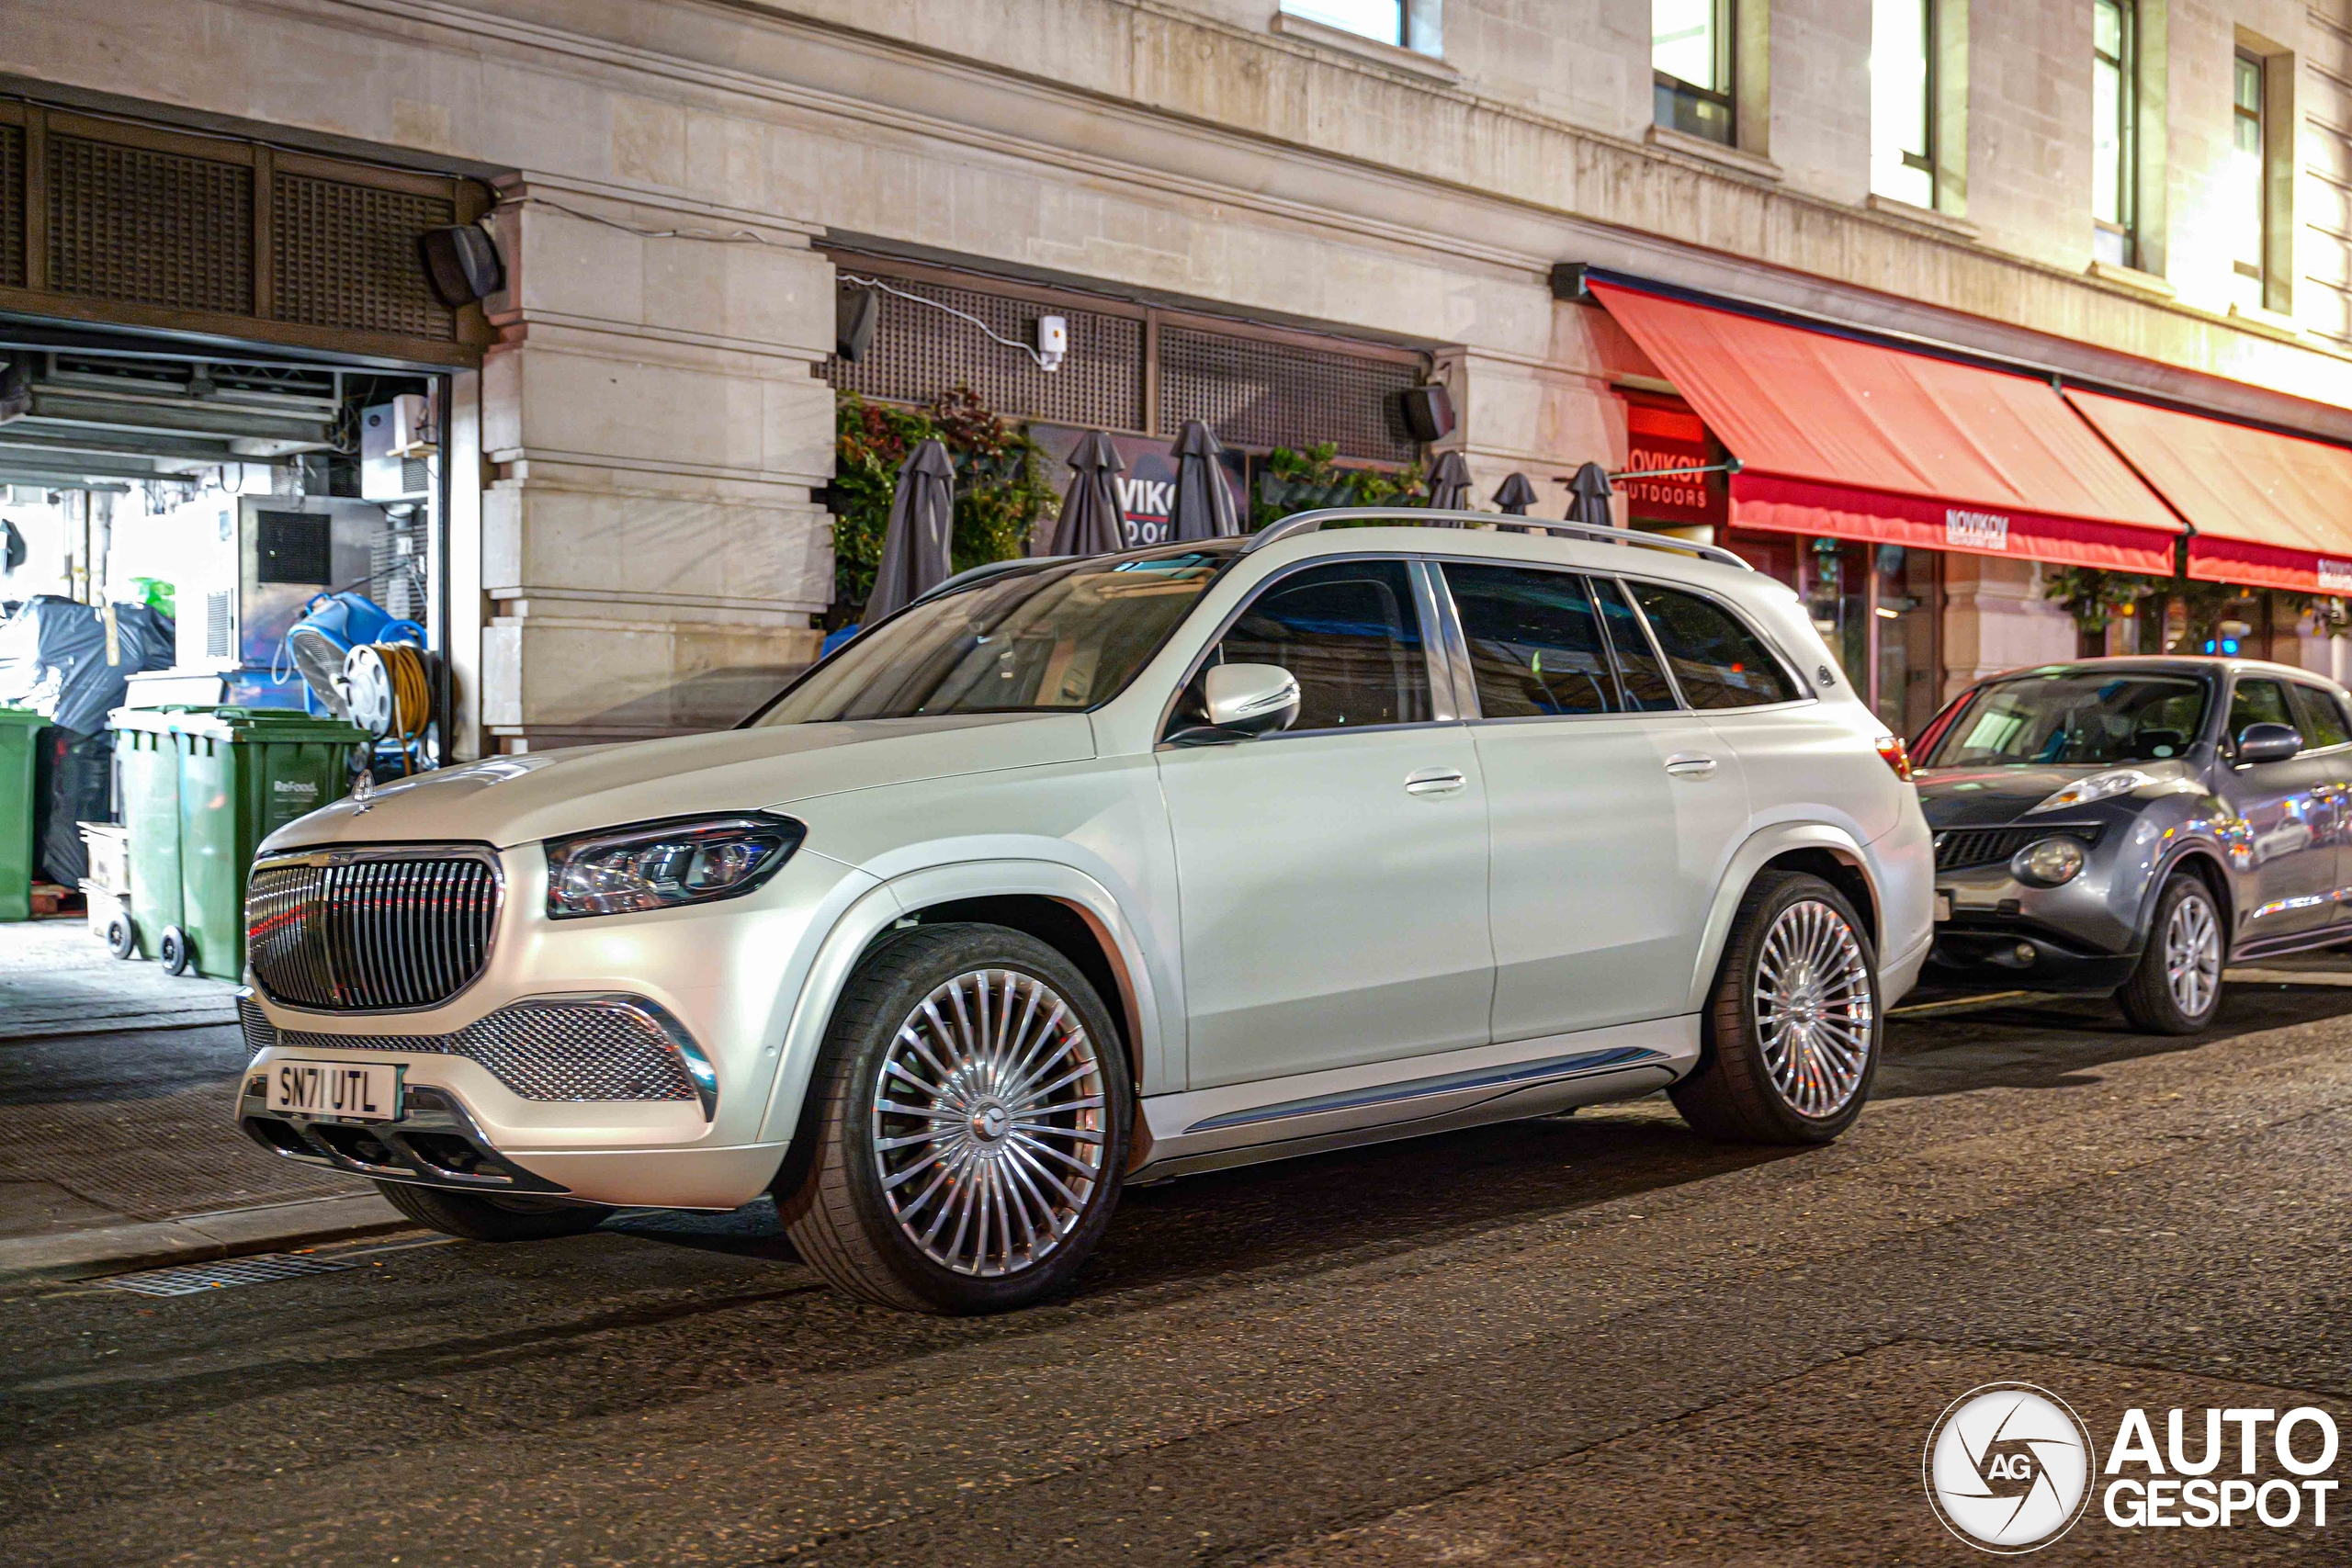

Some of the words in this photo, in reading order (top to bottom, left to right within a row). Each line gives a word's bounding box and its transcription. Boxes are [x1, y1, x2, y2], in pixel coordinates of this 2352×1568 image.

[1946, 509, 2009, 539] NOVIKOV
[280, 1066, 324, 1109] SN71
[332, 1069, 376, 1112] UTL
